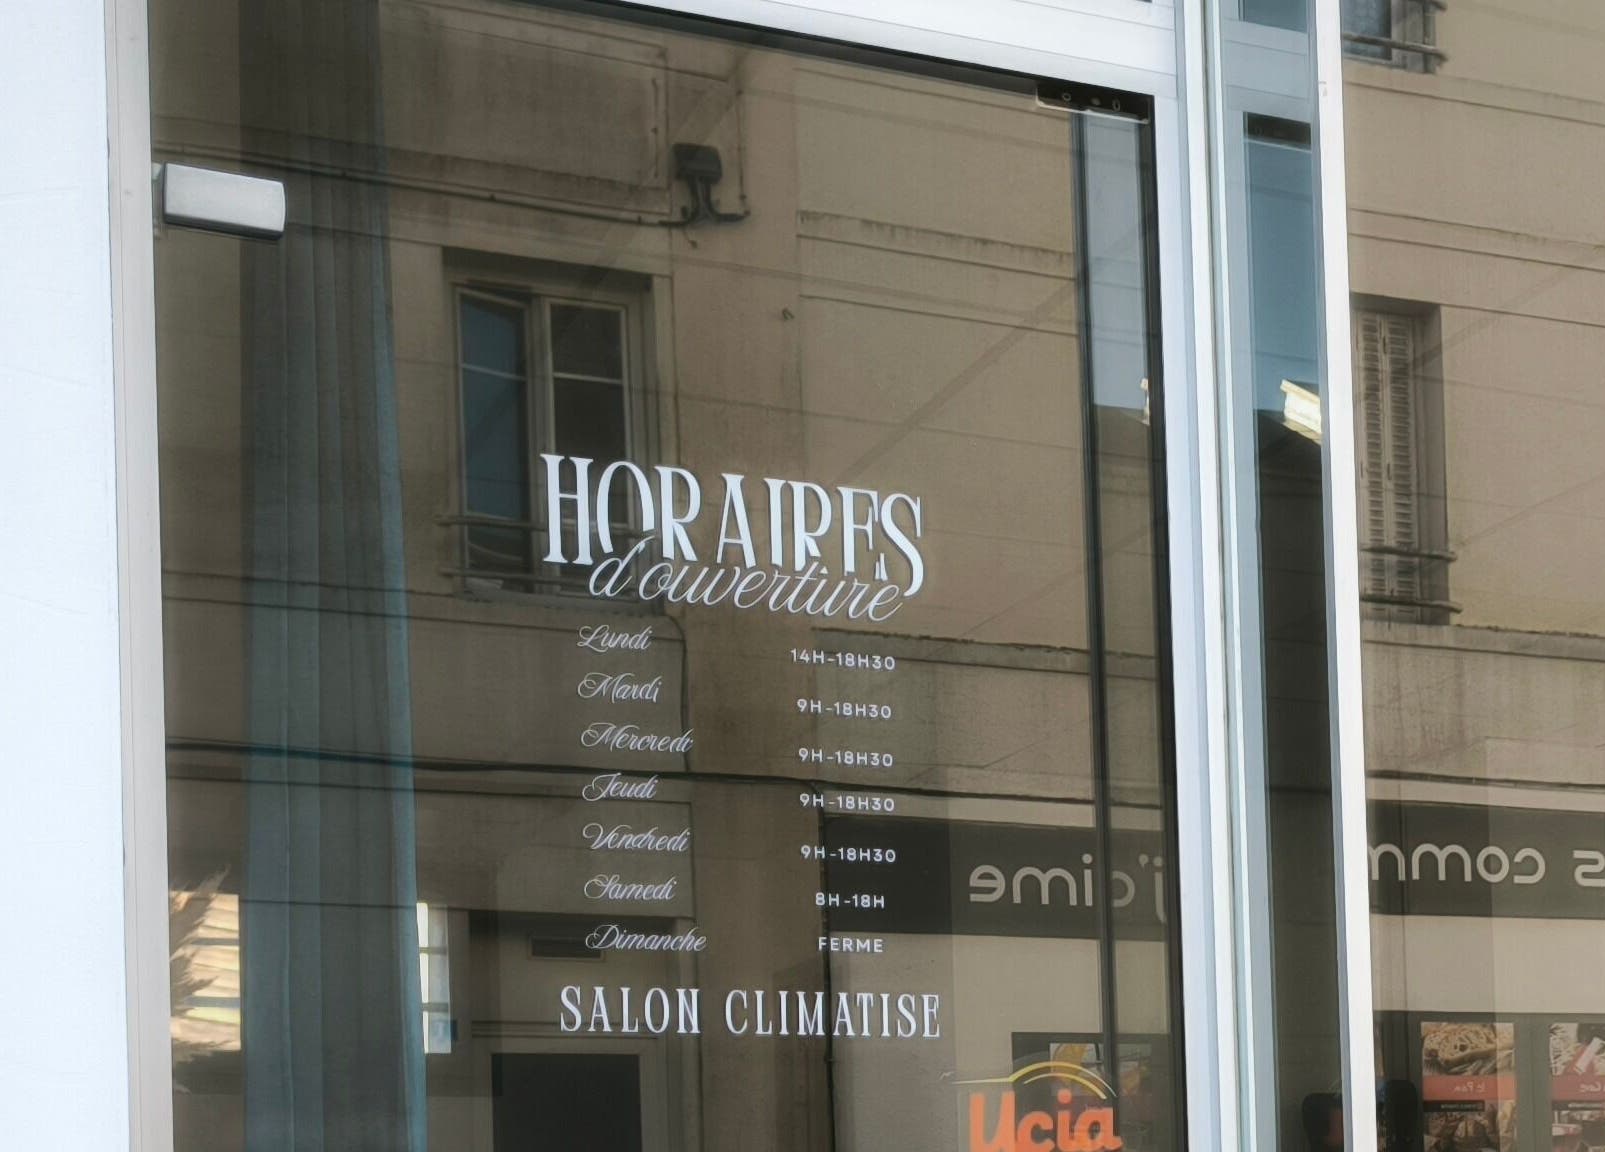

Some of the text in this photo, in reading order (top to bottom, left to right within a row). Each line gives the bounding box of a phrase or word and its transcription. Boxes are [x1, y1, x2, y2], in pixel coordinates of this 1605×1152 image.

[540, 454, 925, 596] HORAIRES
[577, 624, 652, 652] Lundi
[790, 647, 896, 671] 14H-18H30
[577, 672, 662, 704] Mardi
[581, 722, 694, 752] Mercredi
[582, 772, 659, 801] Jeudi
[582, 823, 690, 852] Vendredi
[584, 874, 677, 901] Samedi
[815, 892, 885, 909] 8H-18H
[585, 924, 707, 952] Dimanche
[818, 936, 884, 953] FERME
[559, 985, 940, 1038] SALON CLIMATISE
